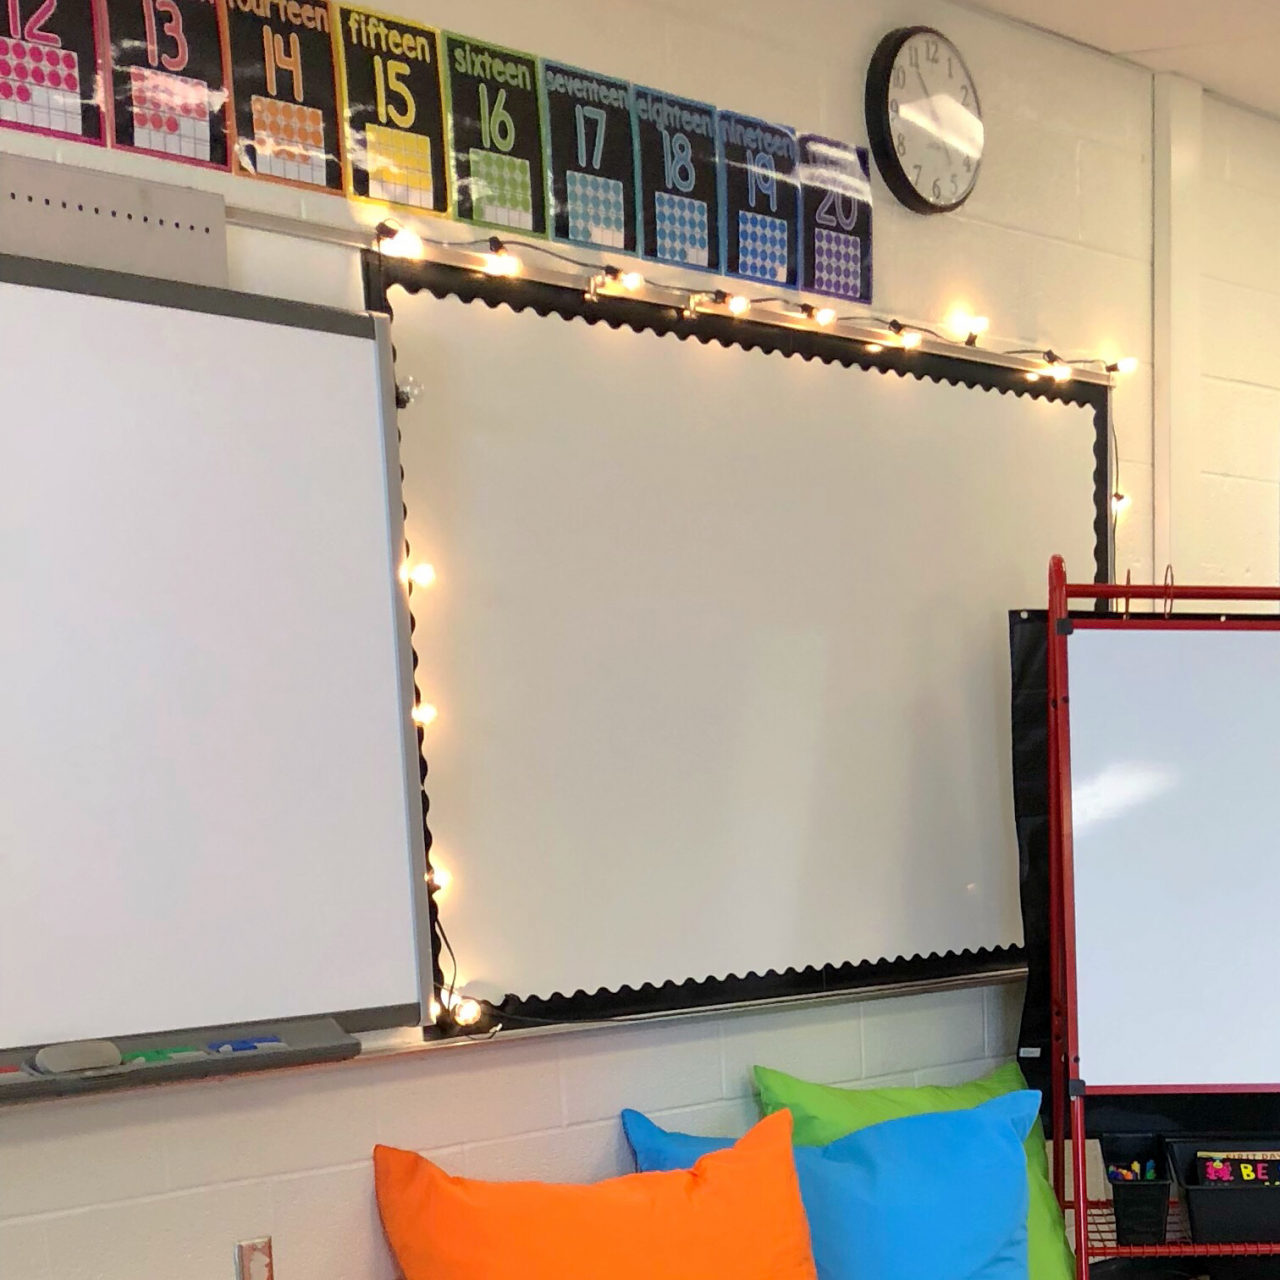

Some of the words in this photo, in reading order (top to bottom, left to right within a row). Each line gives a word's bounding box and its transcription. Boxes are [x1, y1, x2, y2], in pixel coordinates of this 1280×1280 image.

[8, 0, 62, 48] 12
[142, 0, 189, 71] 13
[222, 0, 329, 33] ourteen
[348, 12, 431, 63] fifteen
[262, 24, 304, 103] 14
[453, 43, 531, 91] sixteen
[925, 40, 939, 64] 12
[373, 55, 416, 128] 15
[546, 70, 630, 110] seventeen
[960, 84, 969, 106] 2
[478, 83, 516, 151] 16
[575, 104, 607, 169] 17
[636, 94, 715, 138] eighteen
[718, 118, 795, 160] nineteen
[662, 129, 696, 193] 18
[897, 132, 906, 157] 8
[746, 149, 777, 213] 19
[913, 164, 922, 186] 7
[932, 178, 941, 199] 6
[950, 174, 958, 195] 5
[815, 180, 858, 230] 20
